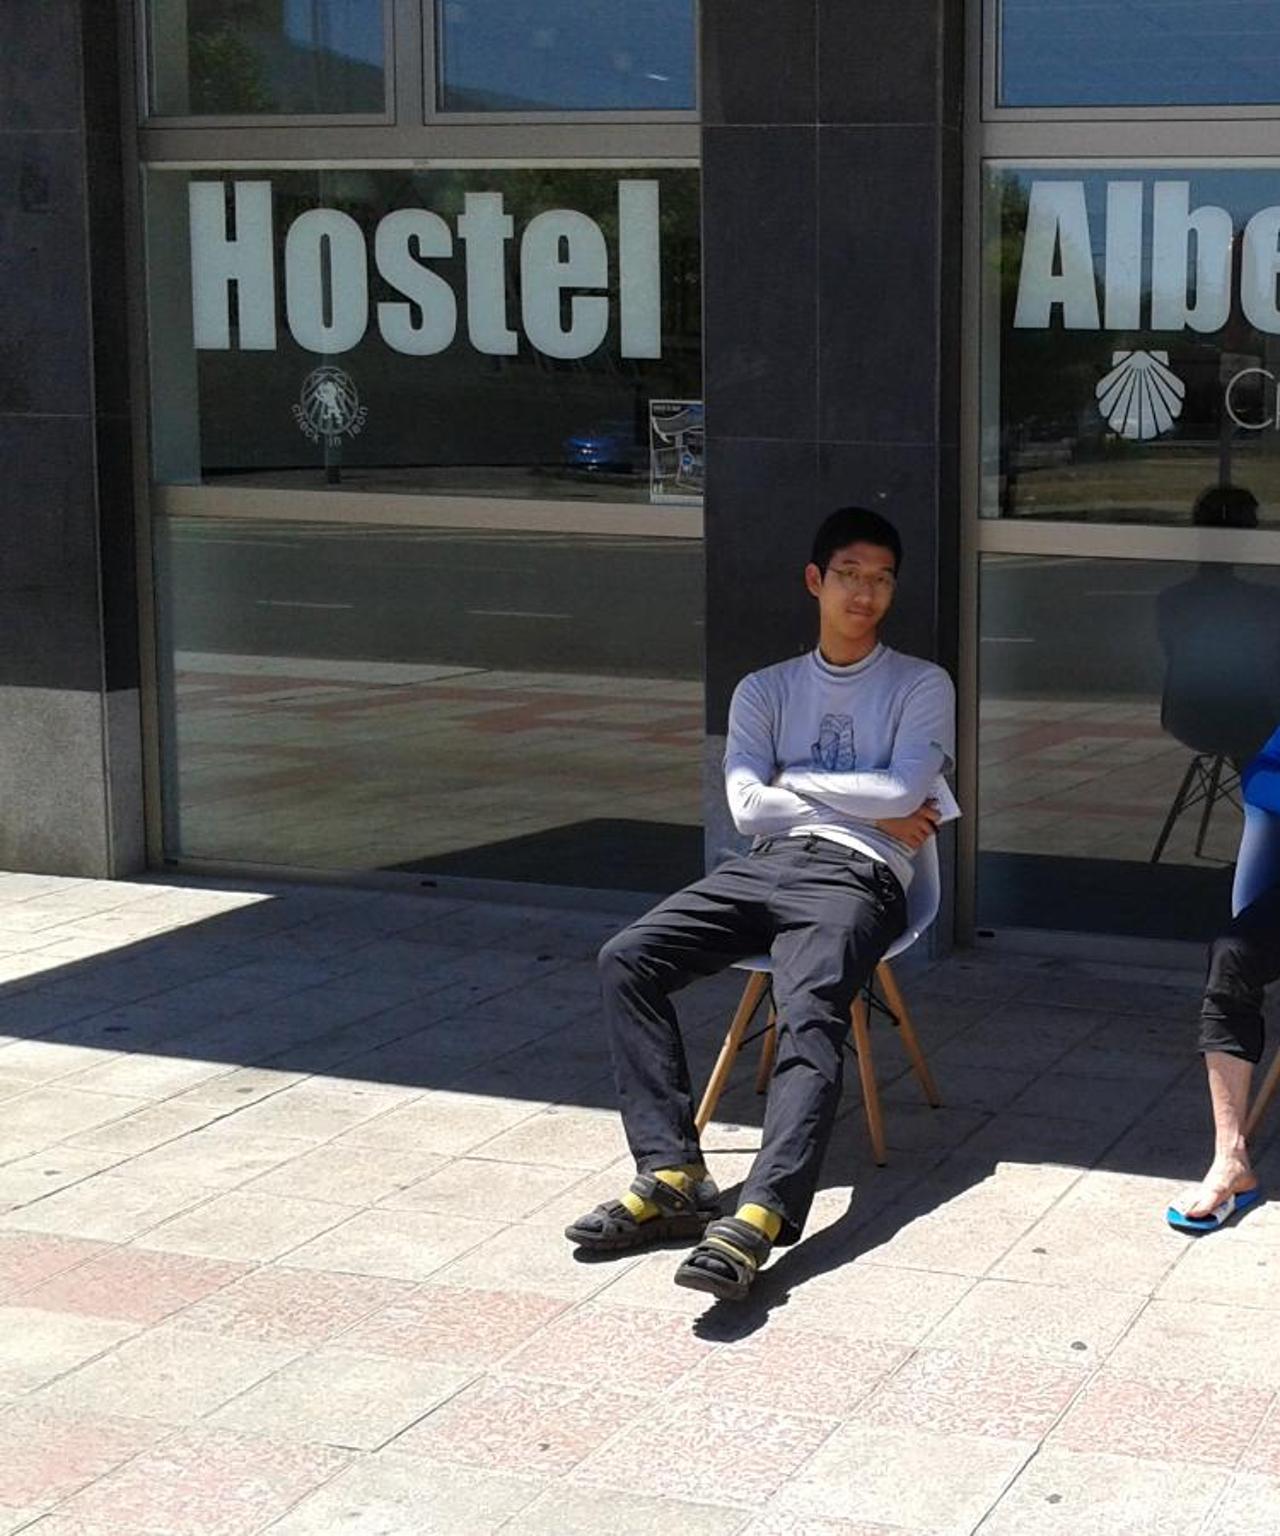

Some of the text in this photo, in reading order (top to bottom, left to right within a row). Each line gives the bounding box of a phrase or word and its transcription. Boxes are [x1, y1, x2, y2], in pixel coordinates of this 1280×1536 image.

[189, 179, 662, 359] Hostel
[290, 404, 321, 444] check
[328, 436, 342, 448] in
